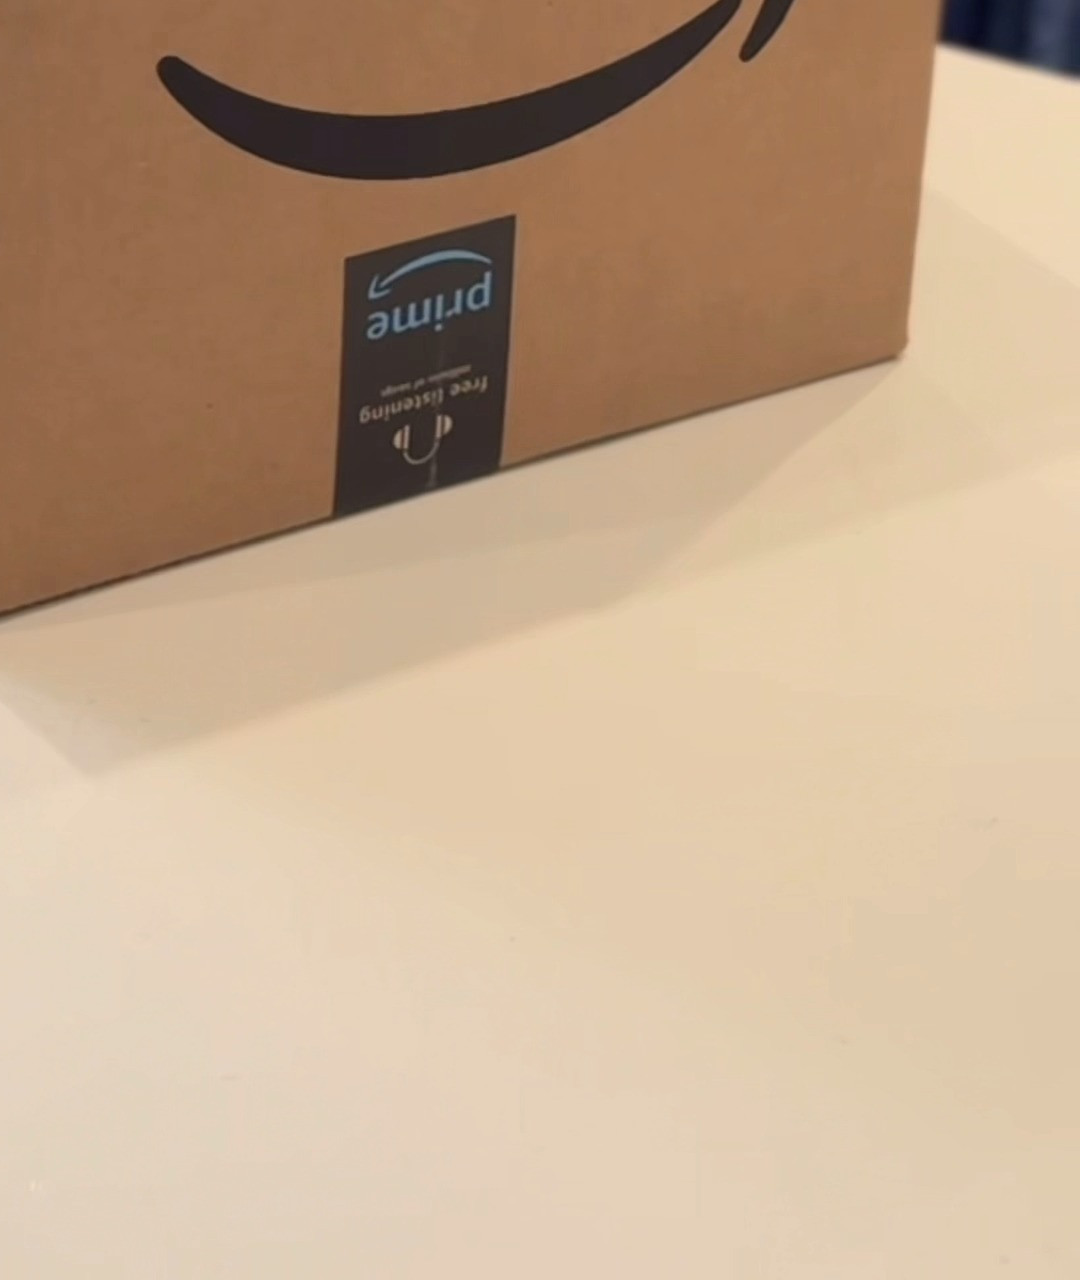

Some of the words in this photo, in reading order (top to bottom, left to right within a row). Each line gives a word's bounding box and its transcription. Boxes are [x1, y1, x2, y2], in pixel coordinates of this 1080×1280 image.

[366, 271, 493, 340] prime
[449, 376, 488, 397] free
[359, 387, 444, 424] listening
